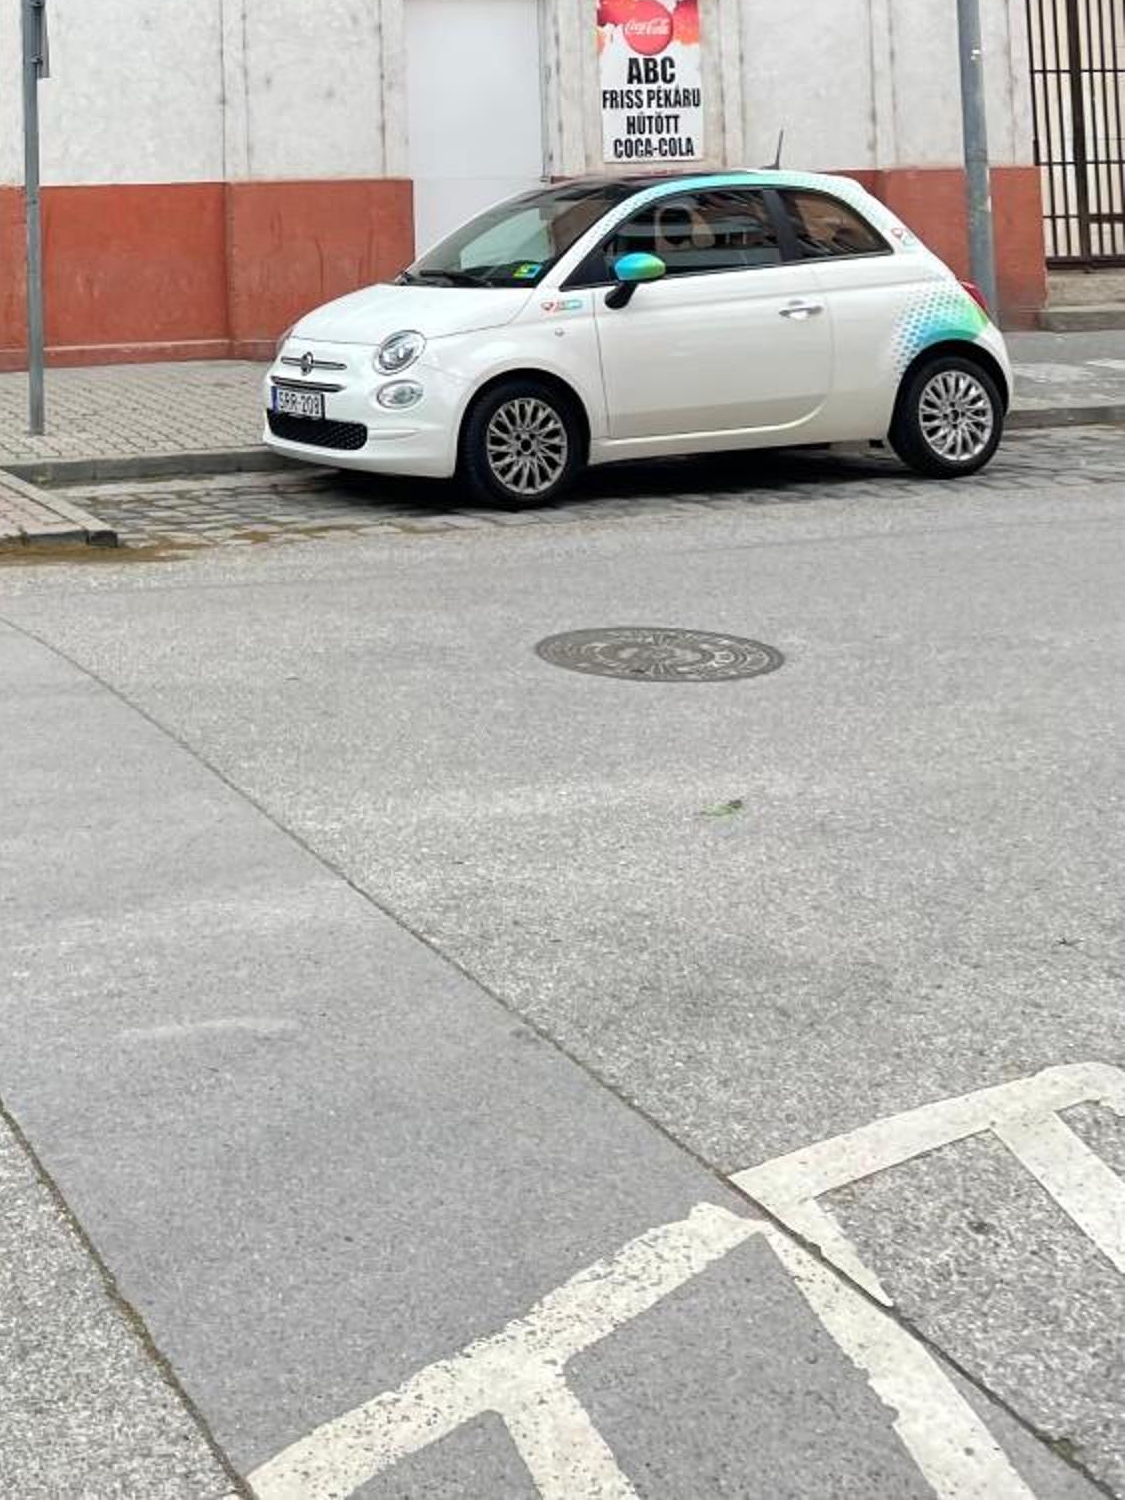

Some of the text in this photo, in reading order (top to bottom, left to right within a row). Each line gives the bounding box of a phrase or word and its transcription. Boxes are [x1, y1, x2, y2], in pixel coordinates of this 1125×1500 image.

[626, 56, 676, 85] ABC
[602, 83, 701, 109] FRISS PÉKÁRU
[613, 137, 695, 158] COCA-COLA
